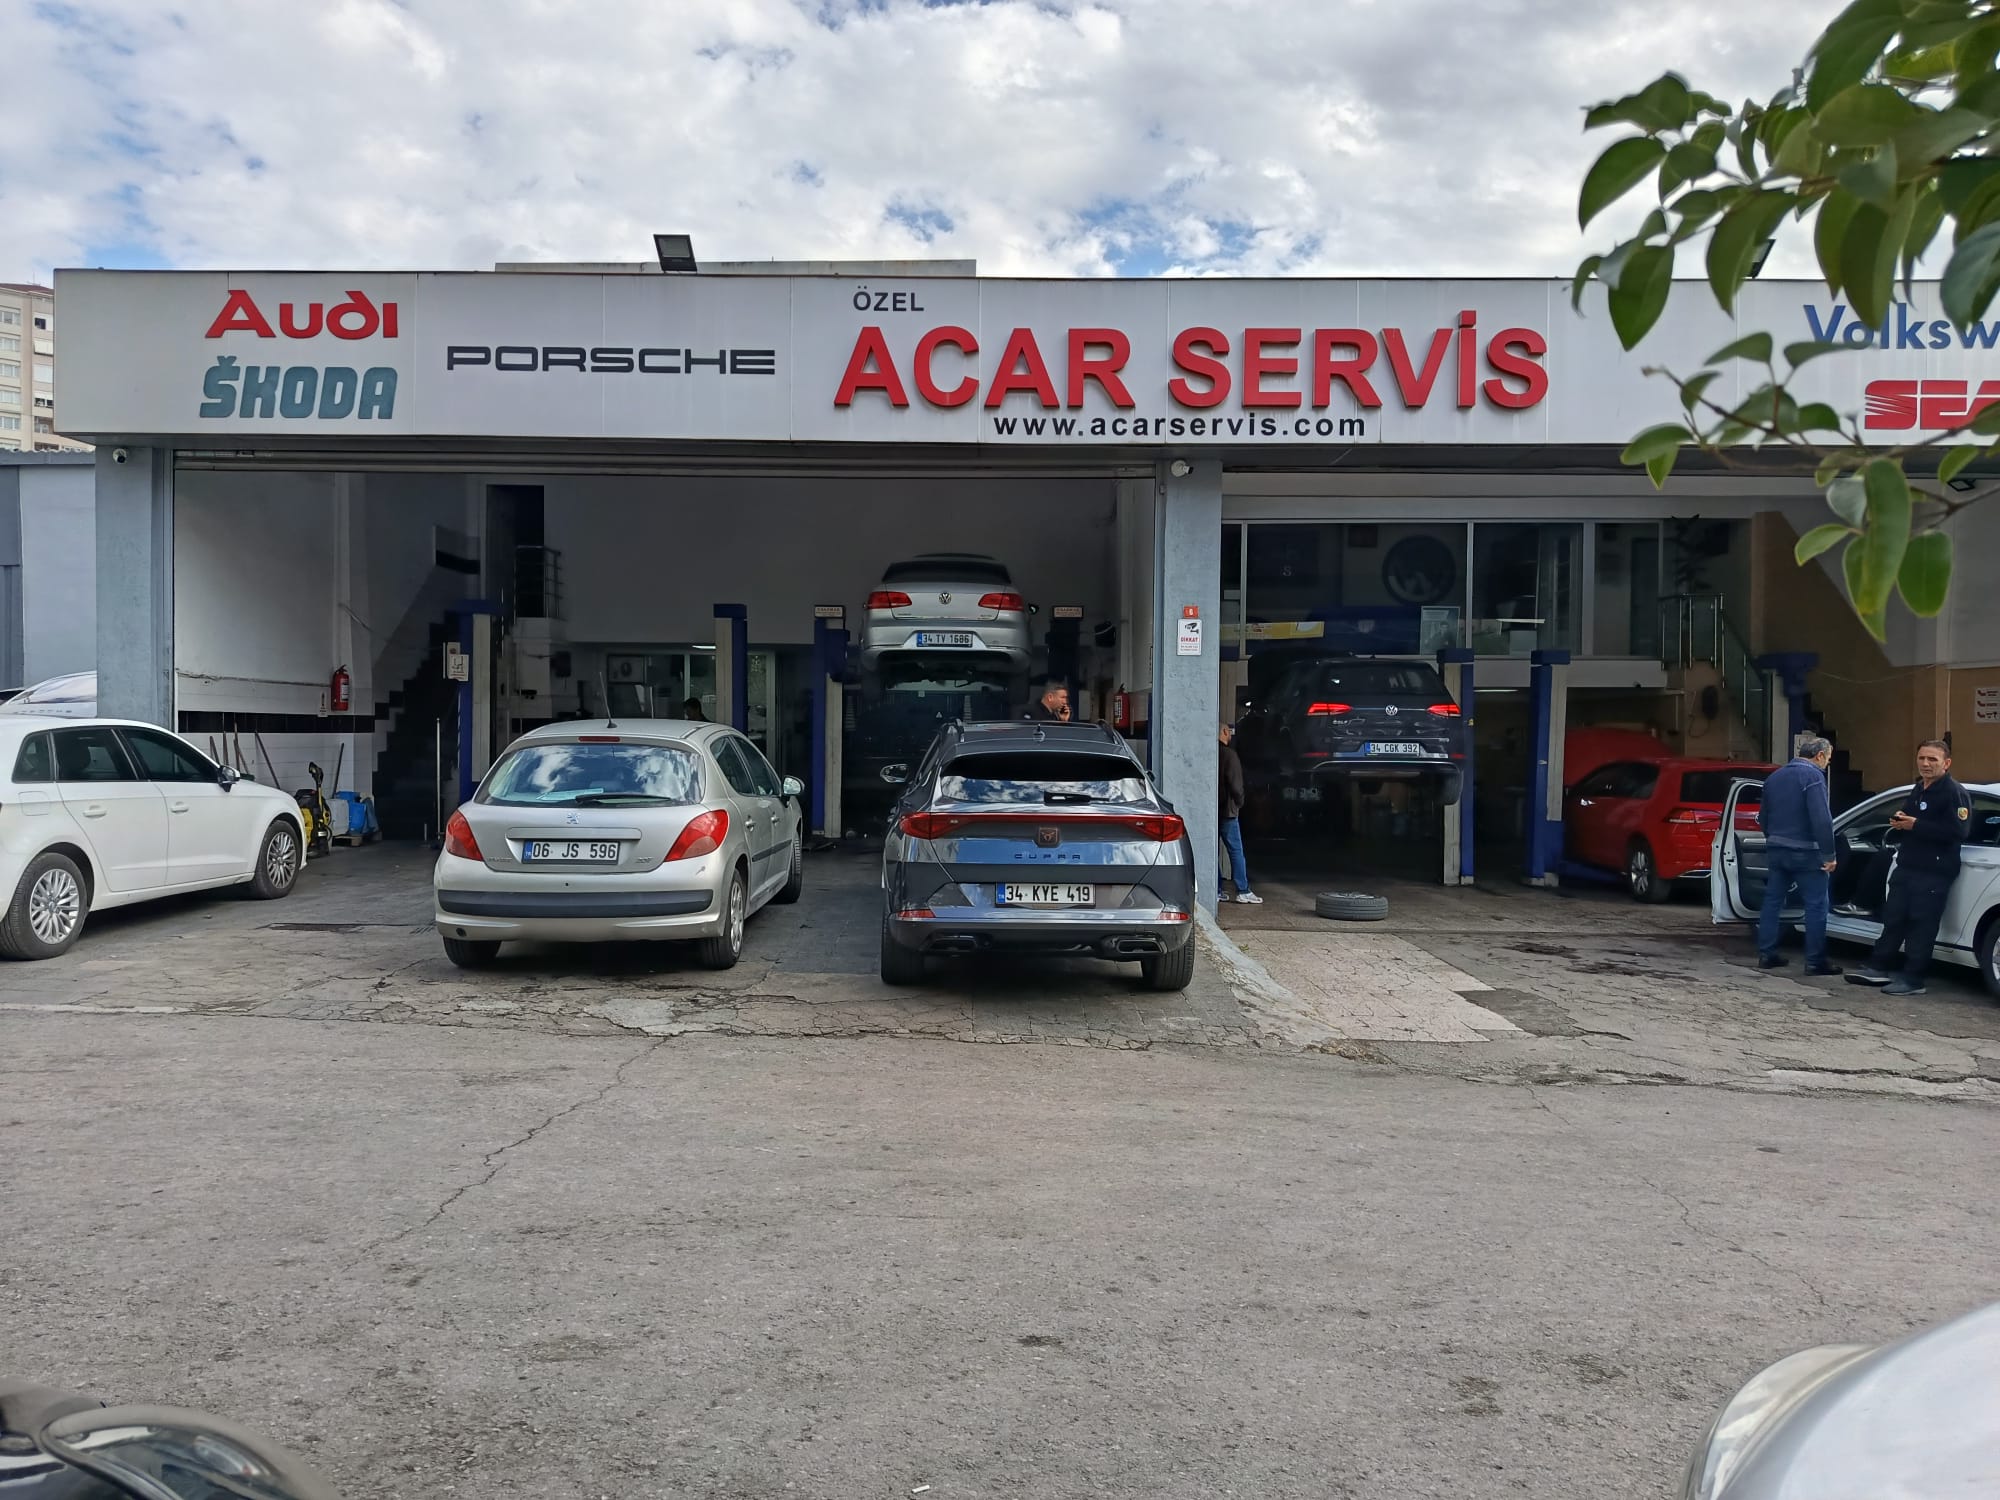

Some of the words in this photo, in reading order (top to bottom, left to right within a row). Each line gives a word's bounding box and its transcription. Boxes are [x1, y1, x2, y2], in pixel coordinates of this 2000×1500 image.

[852, 286, 925, 312] ÖZEL
[204, 290, 398, 339] Audi
[447, 346, 776, 375] PORSCHE
[834, 325, 1136, 407] ACAR
[1168, 310, 1549, 410] SERVİS
[199, 356, 398, 420] ŠKODA
[994, 412, 1365, 437] www.acarservis.com
[923, 634, 933, 643] 34
[1370, 744, 1381, 753] 34
[1384, 744, 1400, 753] CGK
[1402, 744, 1418, 753] 392
[533, 843, 551, 858] 06
[562, 843, 579, 858] JS
[590, 844, 616, 859] 596
[1006, 886, 1023, 901] 34
[1032, 885, 1059, 901] KYE
[1067, 886, 1090, 901] 419
